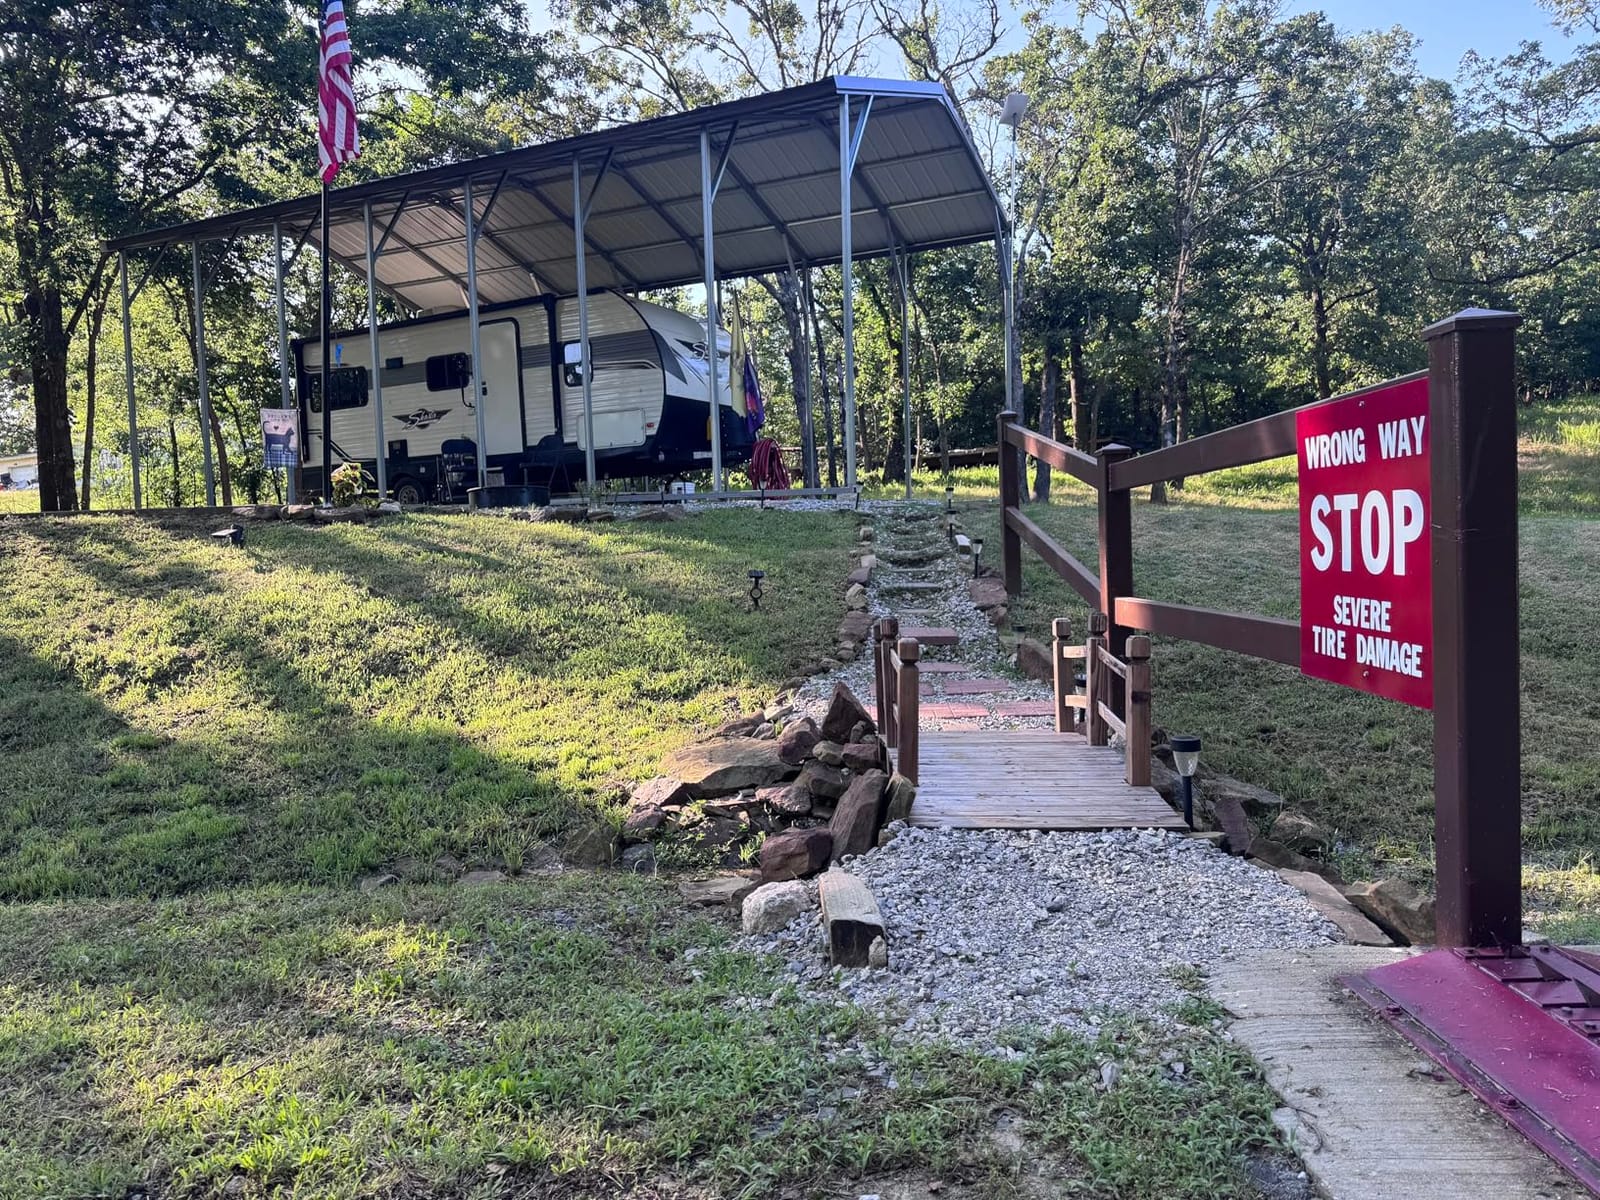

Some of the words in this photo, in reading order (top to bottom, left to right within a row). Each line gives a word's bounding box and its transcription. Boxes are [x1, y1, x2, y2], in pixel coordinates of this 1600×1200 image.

[1305, 428, 1365, 469] WRONG
[1378, 416, 1425, 459] WAY
[1310, 489, 1424, 576] STOP
[1333, 595, 1391, 632] SEVERE
[1312, 626, 1346, 659] TIRE
[1356, 634, 1422, 678] DAMAGE
